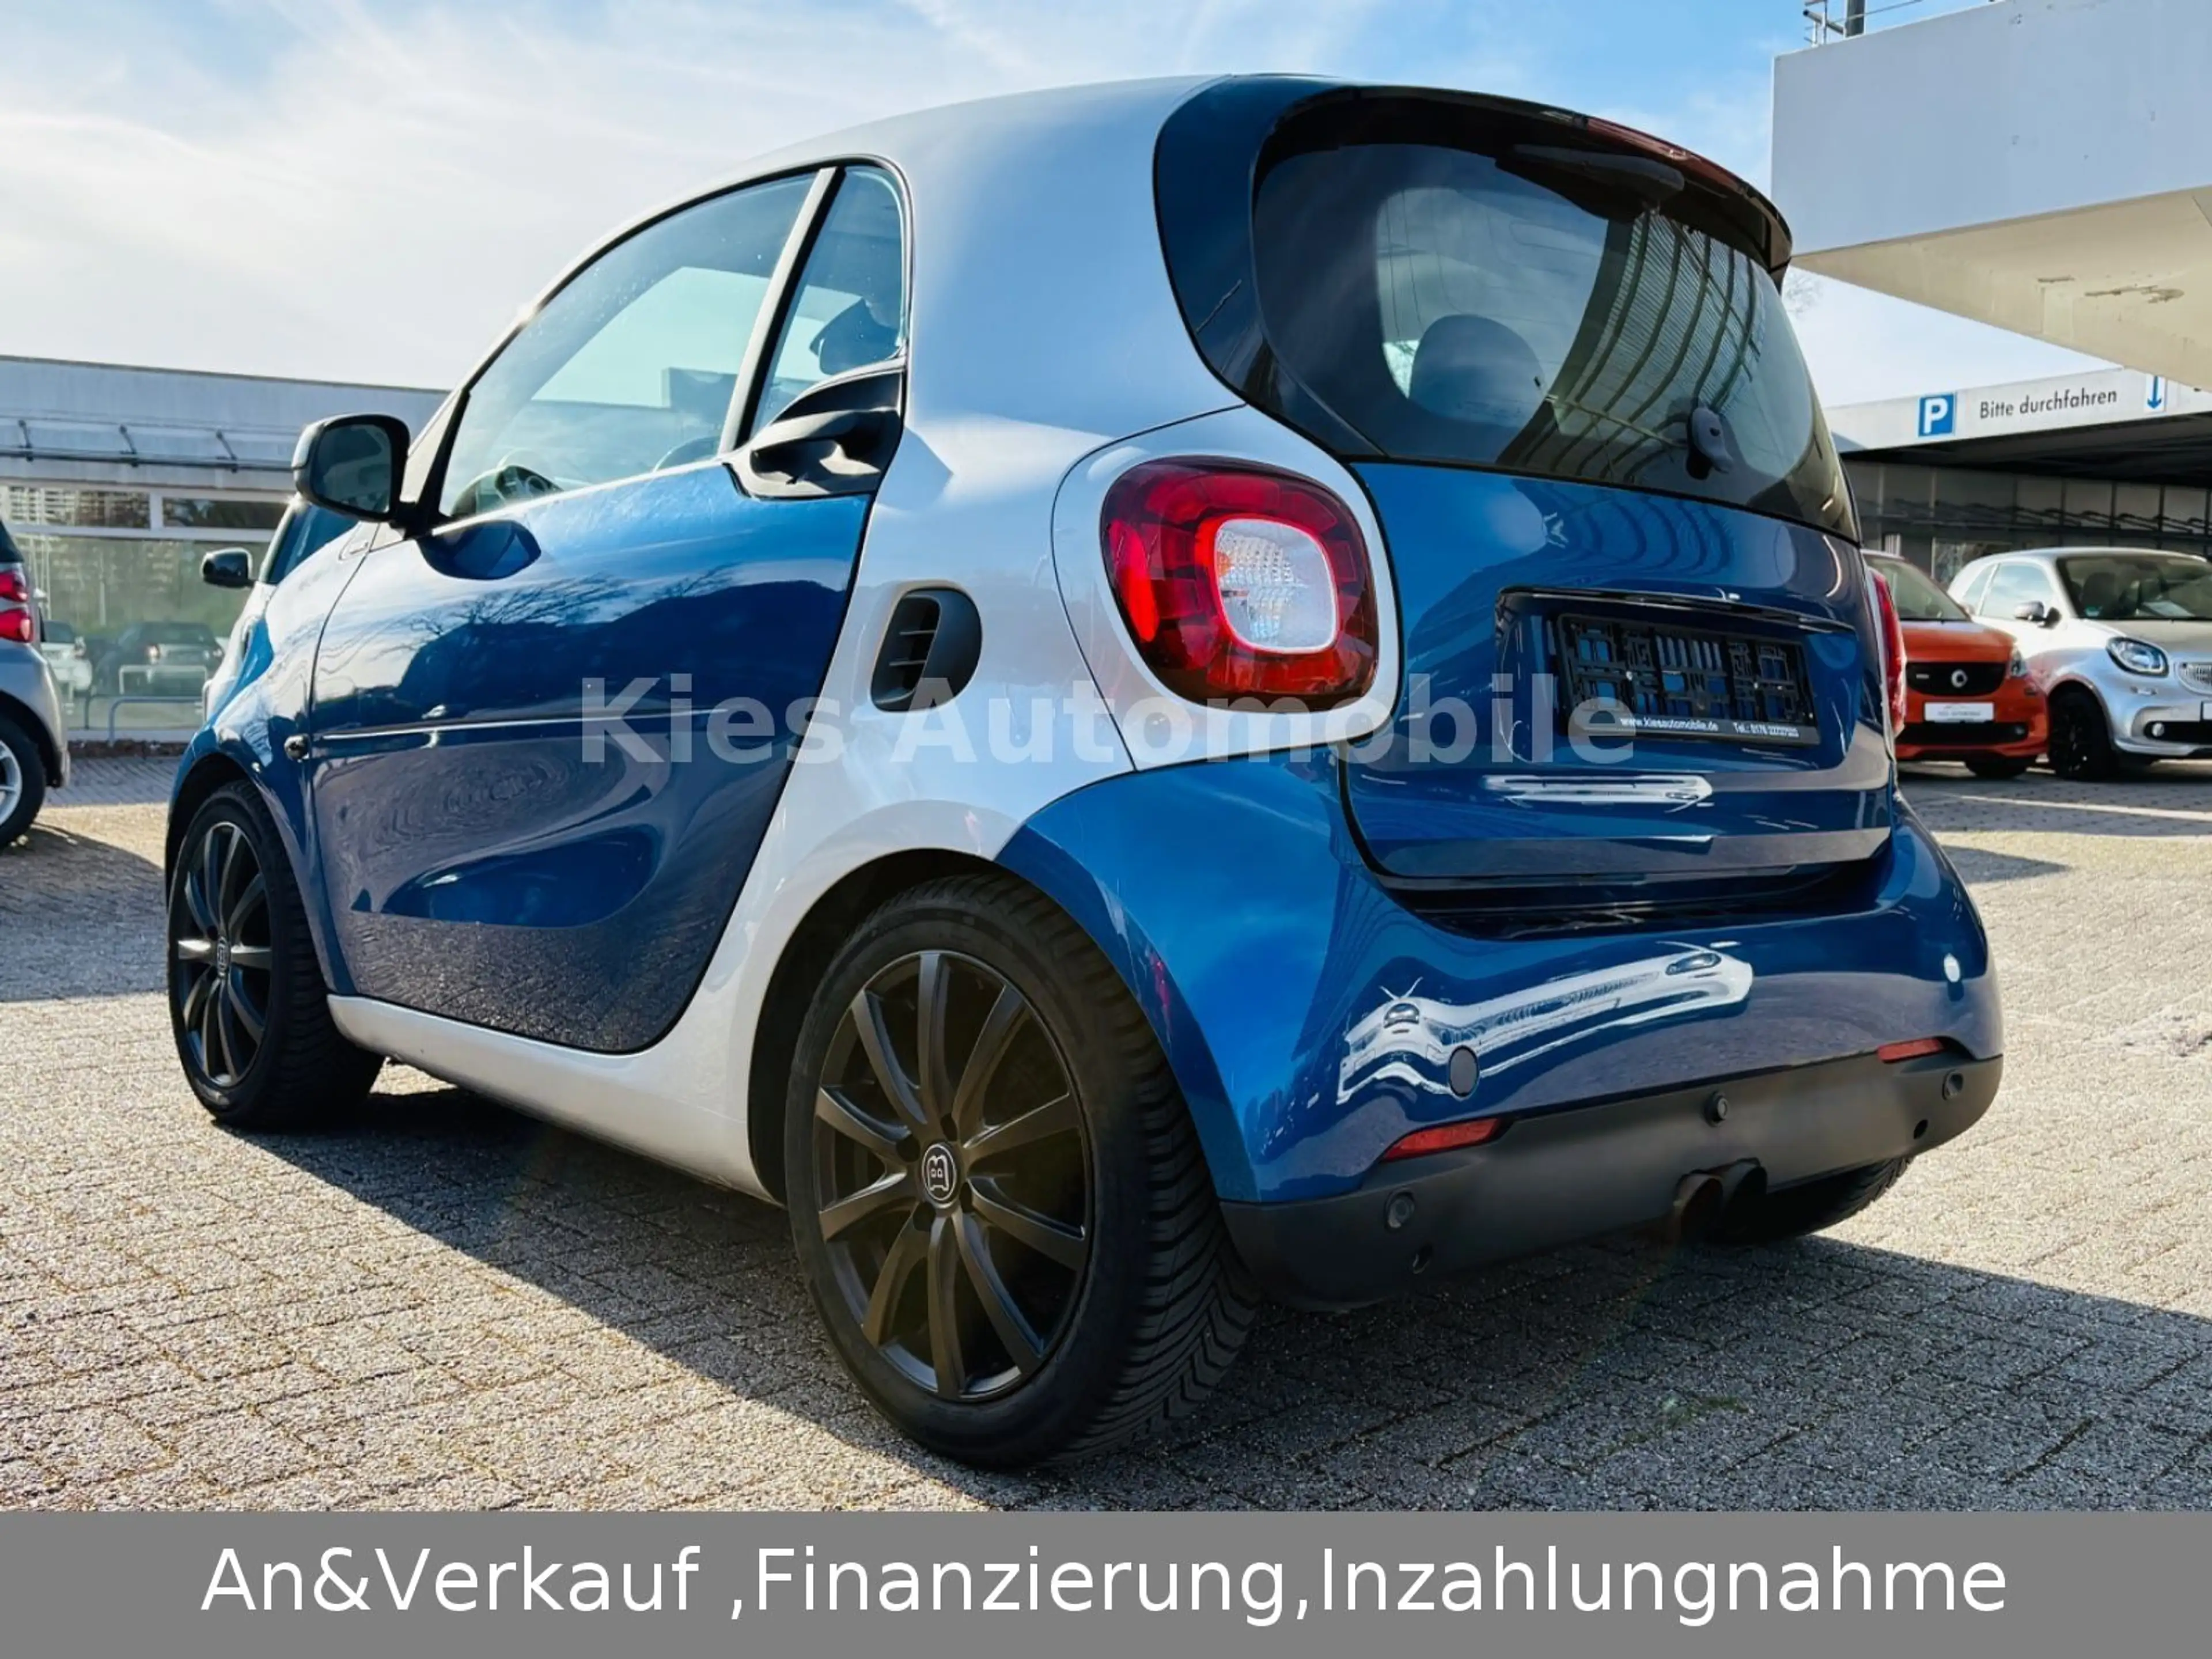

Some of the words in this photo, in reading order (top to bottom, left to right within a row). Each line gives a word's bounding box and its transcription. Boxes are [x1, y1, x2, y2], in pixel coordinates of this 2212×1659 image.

[1923, 397, 1948, 434] P
[1980, 401, 2014, 419] Bitte
[2019, 387, 2118, 414] durchfahren
